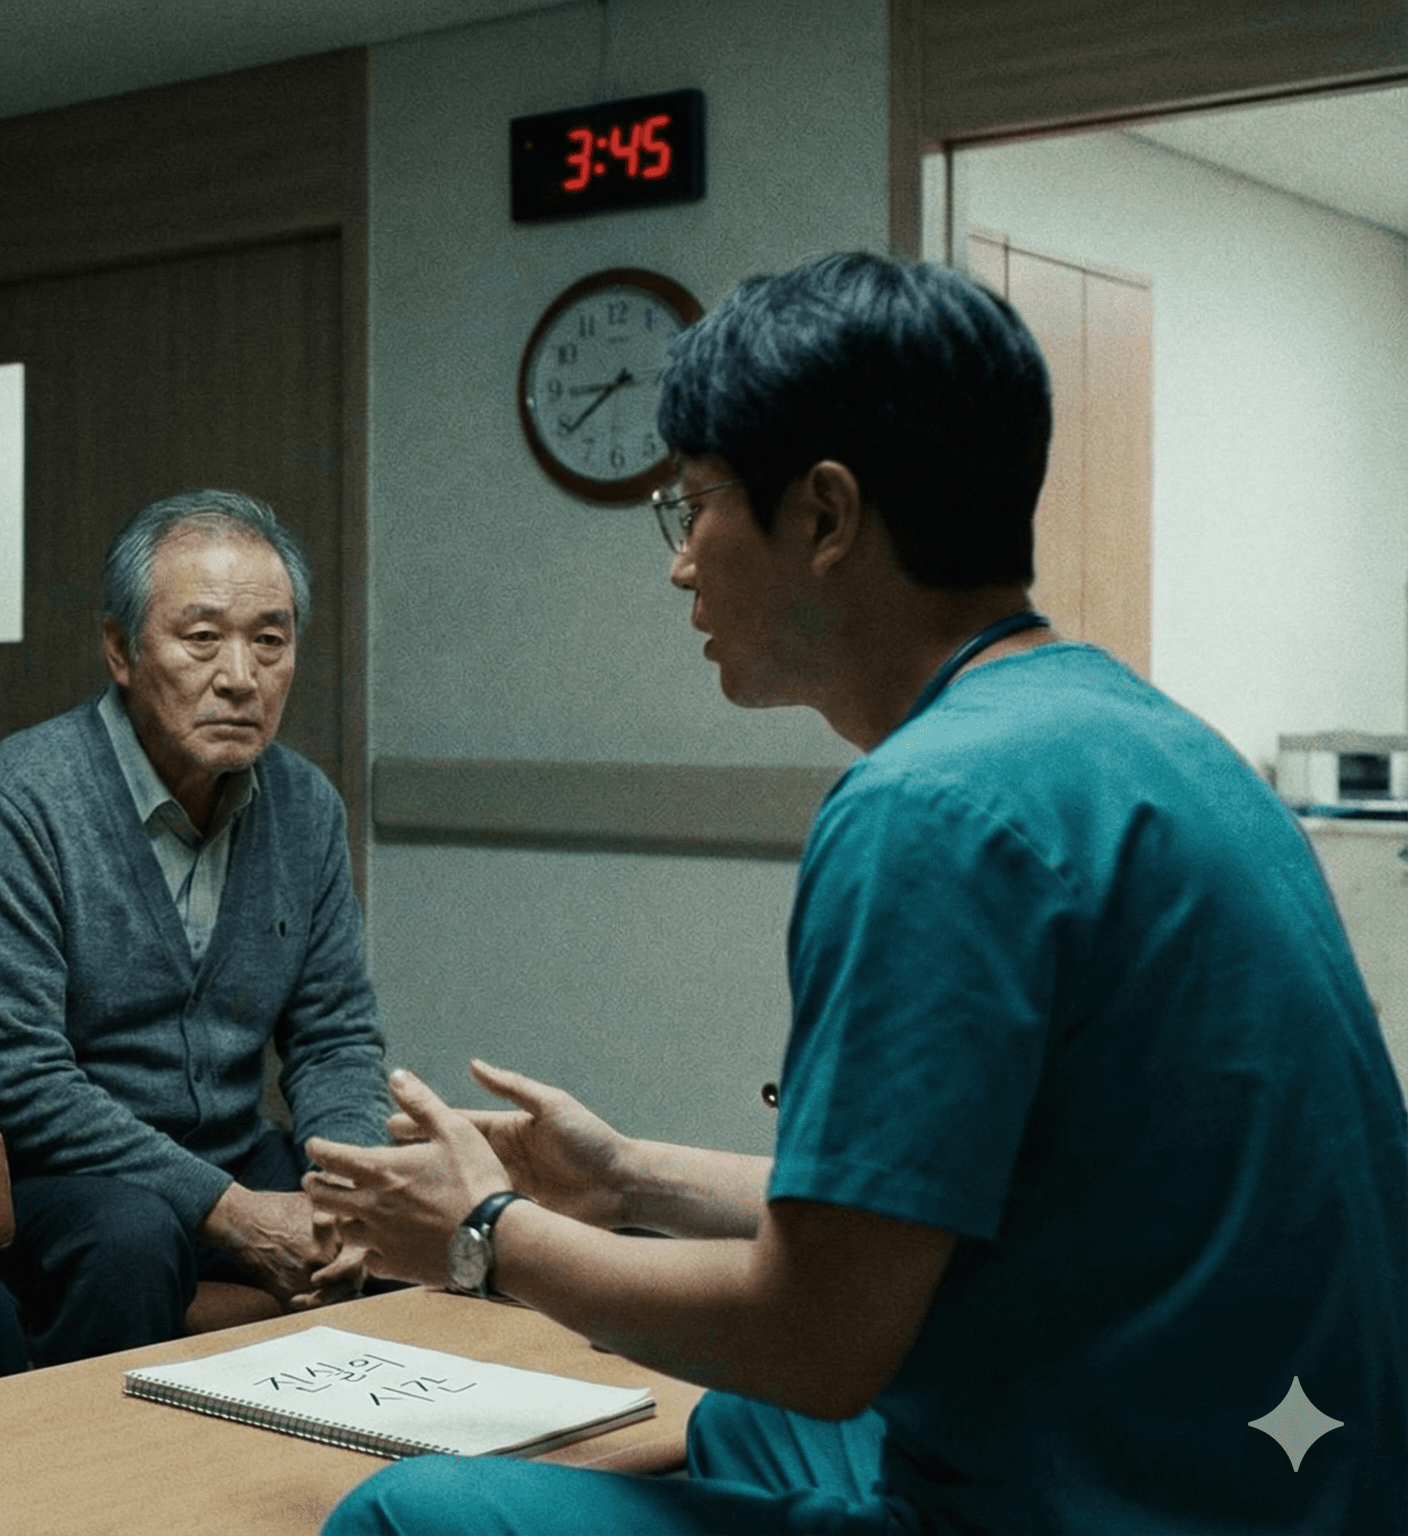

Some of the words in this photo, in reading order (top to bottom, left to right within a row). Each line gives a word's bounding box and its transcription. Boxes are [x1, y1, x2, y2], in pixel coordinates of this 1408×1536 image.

[562, 114, 673, 192] 3:45
[608, 301, 628, 326] 12
[578, 314, 596, 338] 11
[558, 344, 578, 365] 10
[548, 379, 562, 402] 9
[581, 438, 595, 462] 7
[610, 445, 625, 469] 6
[643, 433, 656, 457] 5
[253, 1354, 405, 1393] 진실의
[369, 1376, 477, 1406] 시간
